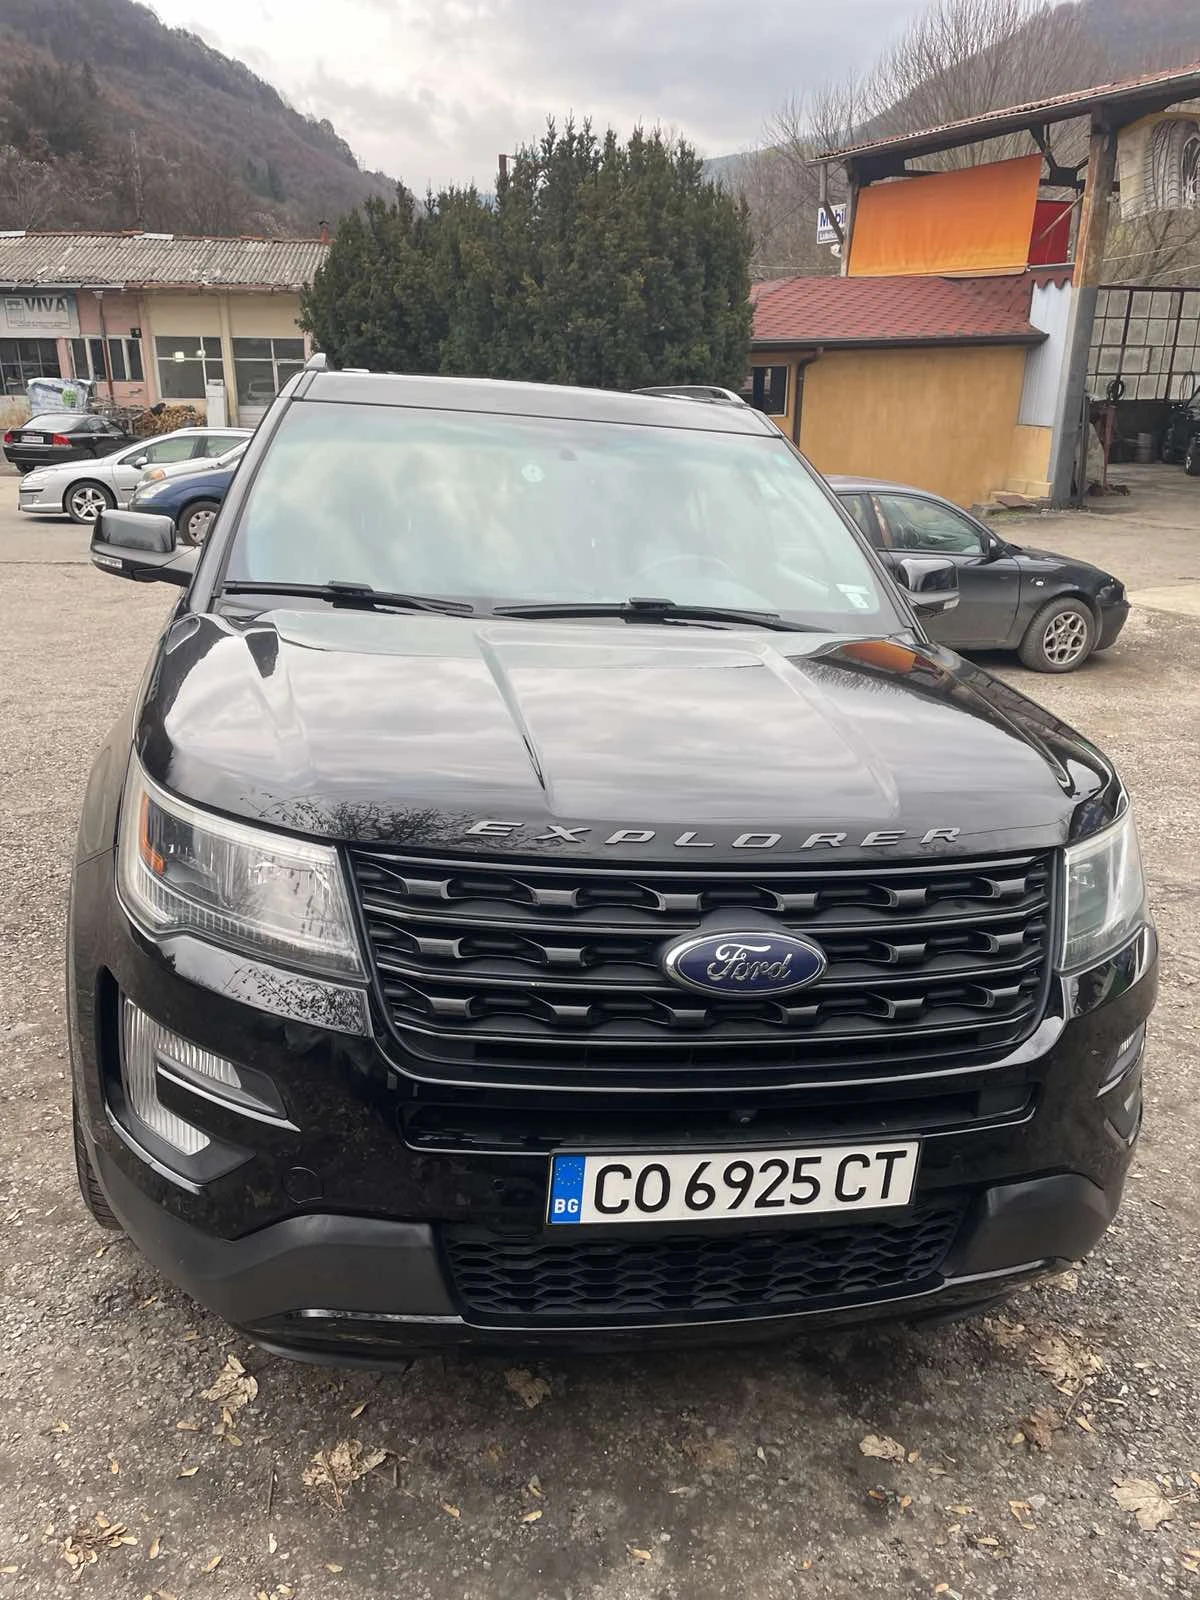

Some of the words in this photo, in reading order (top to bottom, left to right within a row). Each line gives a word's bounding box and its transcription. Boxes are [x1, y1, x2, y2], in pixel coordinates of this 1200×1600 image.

[820, 208, 847, 227] Mbil
[24, 296, 68, 312] VIVA
[465, 820, 961, 848] EXPLORER
[706, 943, 792, 981] Ford
[594, 1163, 671, 1214] CO
[685, 1156, 822, 1212] 6925
[834, 1150, 907, 1202] CT
[554, 1198, 578, 1214] BG
